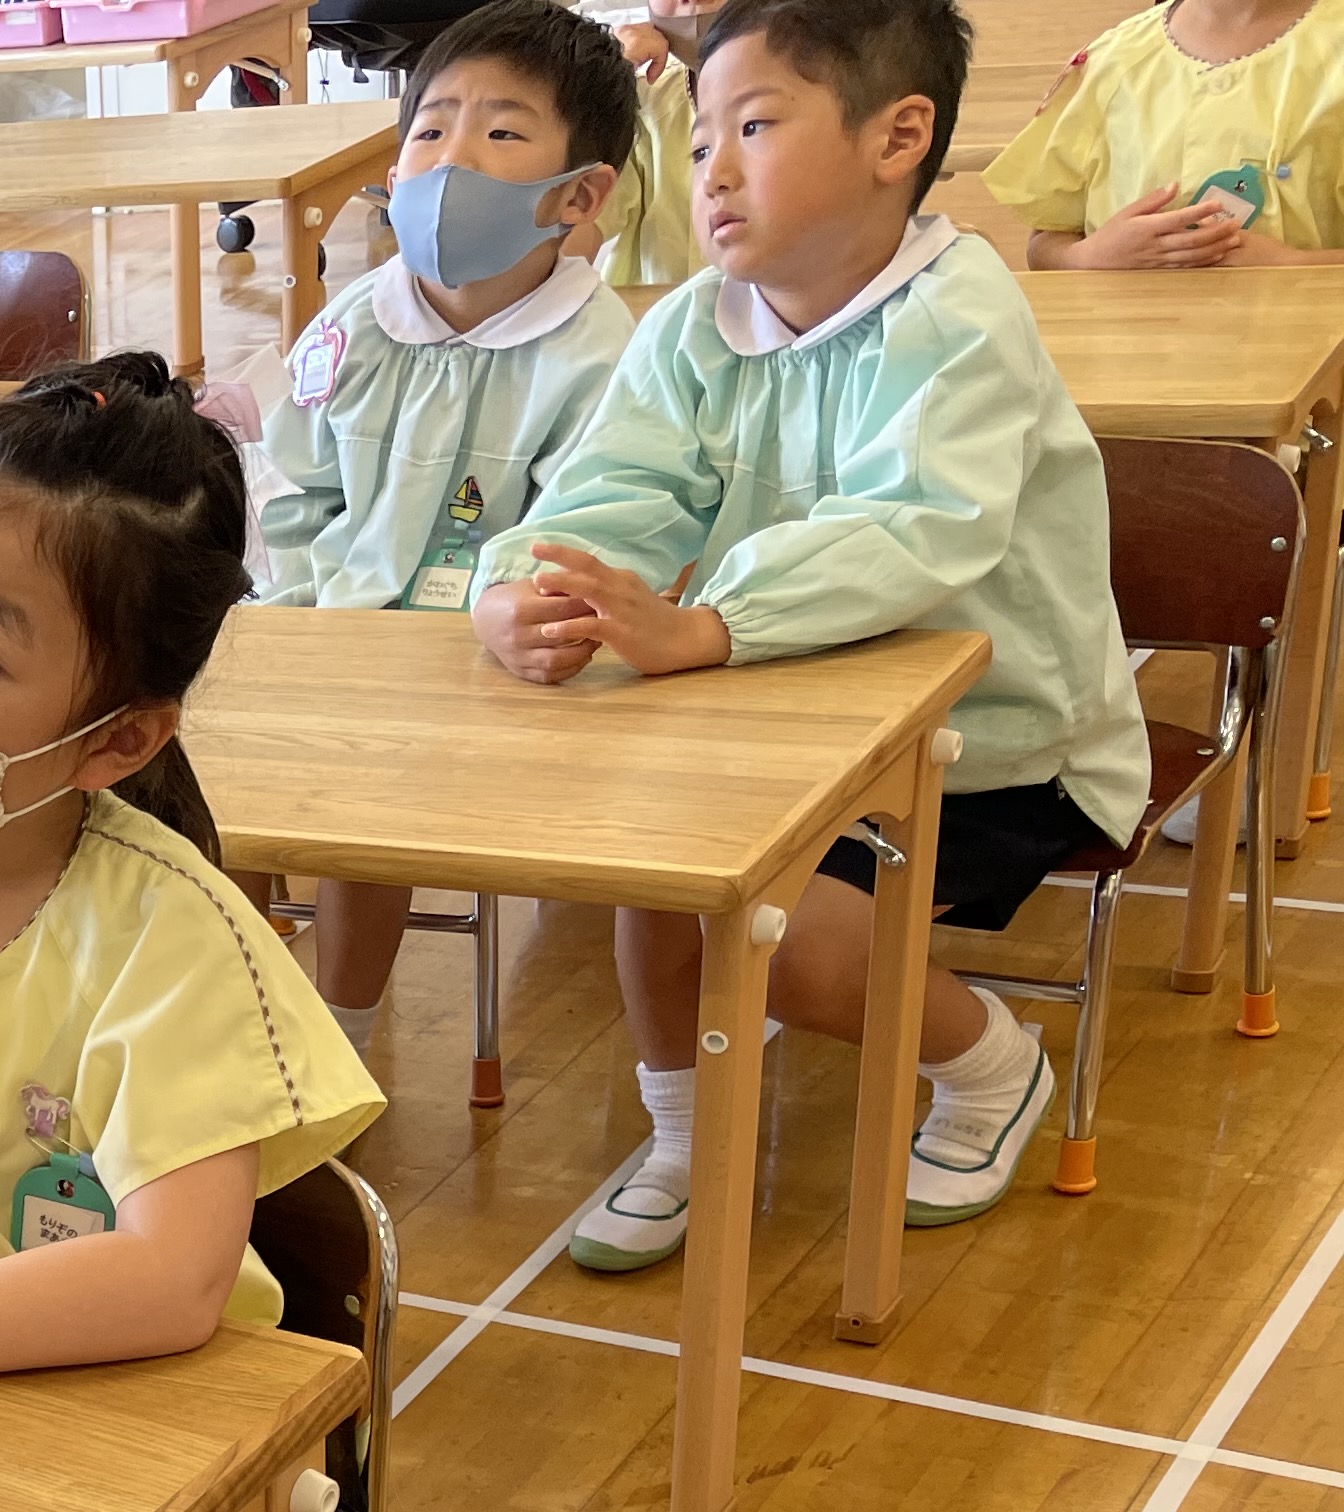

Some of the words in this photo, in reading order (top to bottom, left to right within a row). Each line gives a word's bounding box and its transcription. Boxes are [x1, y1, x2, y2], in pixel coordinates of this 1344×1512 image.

[39, 1214, 79, 1239] もりぞの
[40, 1228, 69, 1243] まあ
